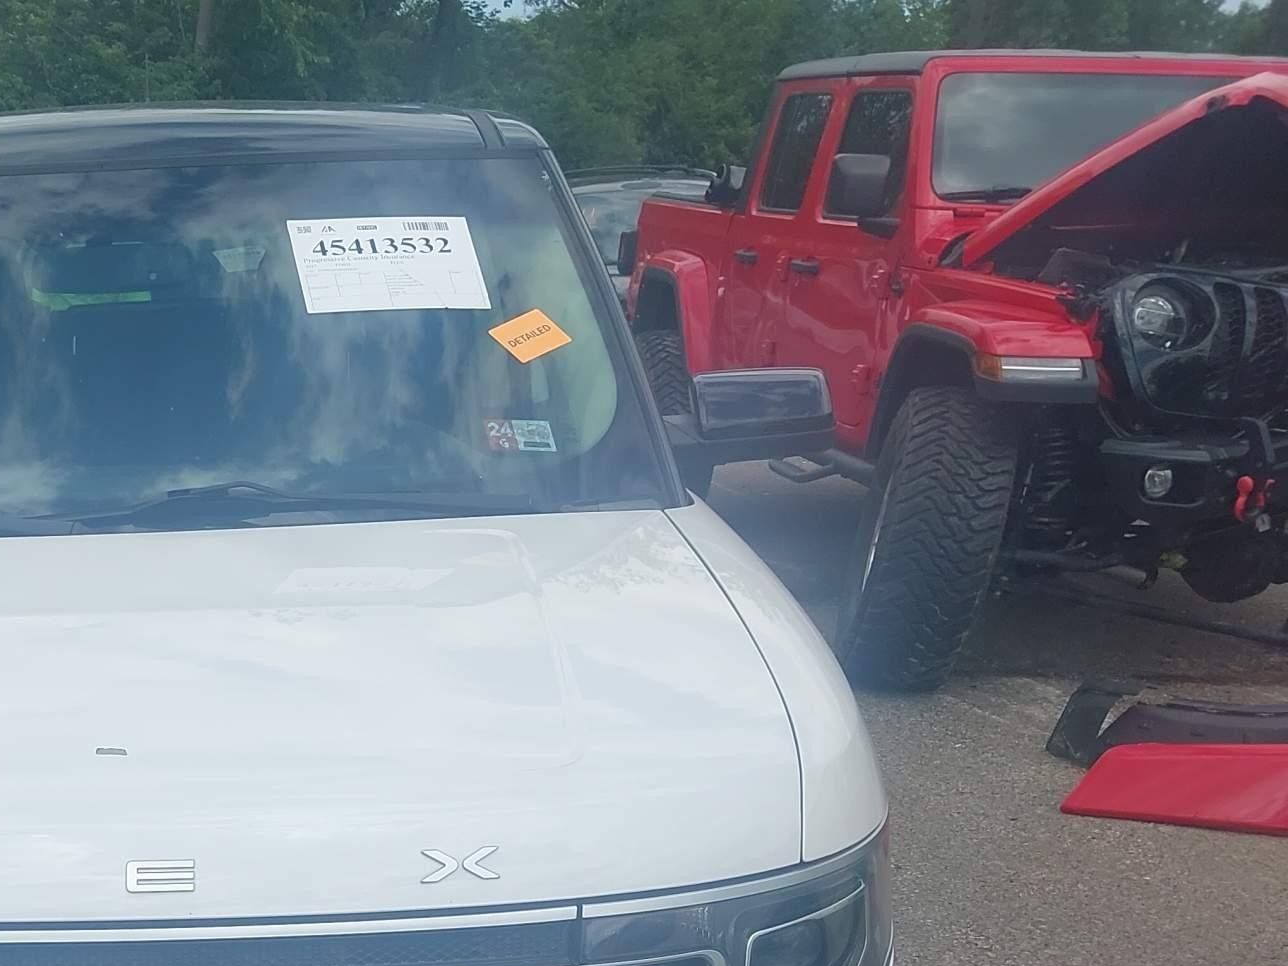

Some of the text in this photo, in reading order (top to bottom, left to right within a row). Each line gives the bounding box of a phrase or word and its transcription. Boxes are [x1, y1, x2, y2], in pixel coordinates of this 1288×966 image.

[312, 236, 452, 257] 45413532
[507, 324, 552, 348] DETAILED
[487, 422, 513, 438] 24
